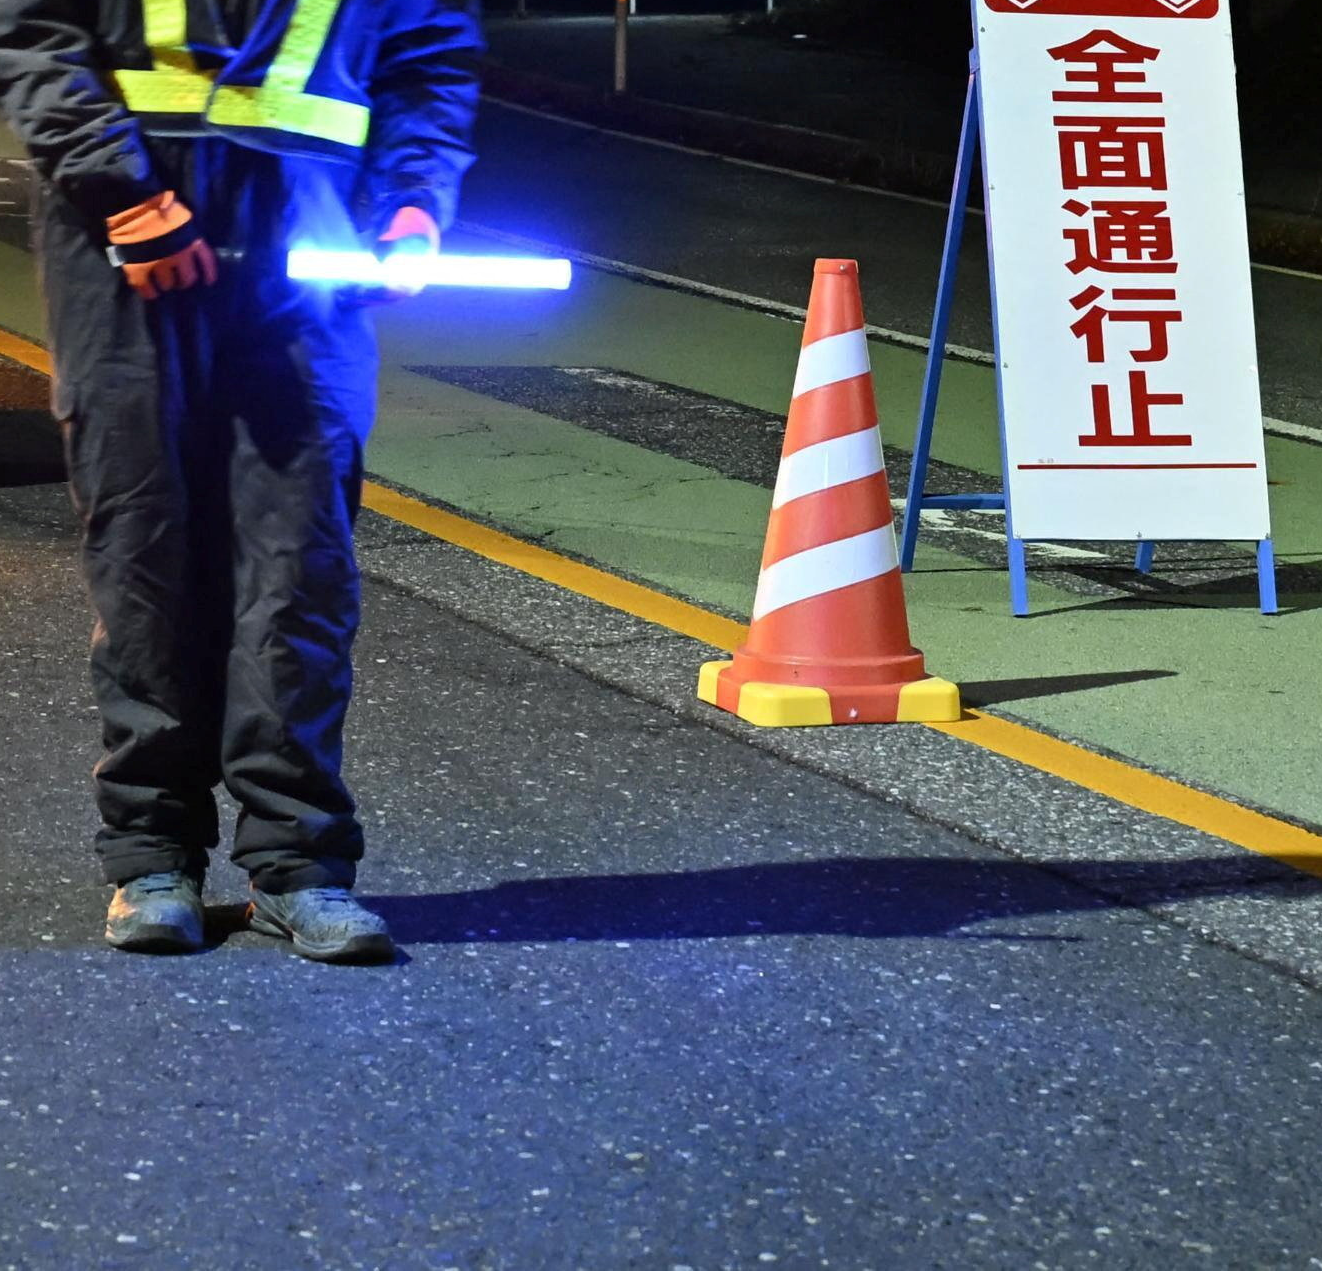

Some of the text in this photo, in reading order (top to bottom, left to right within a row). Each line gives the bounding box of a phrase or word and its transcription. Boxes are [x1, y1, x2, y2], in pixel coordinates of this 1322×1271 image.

[1046, 29, 1192, 446] 全面通行止
